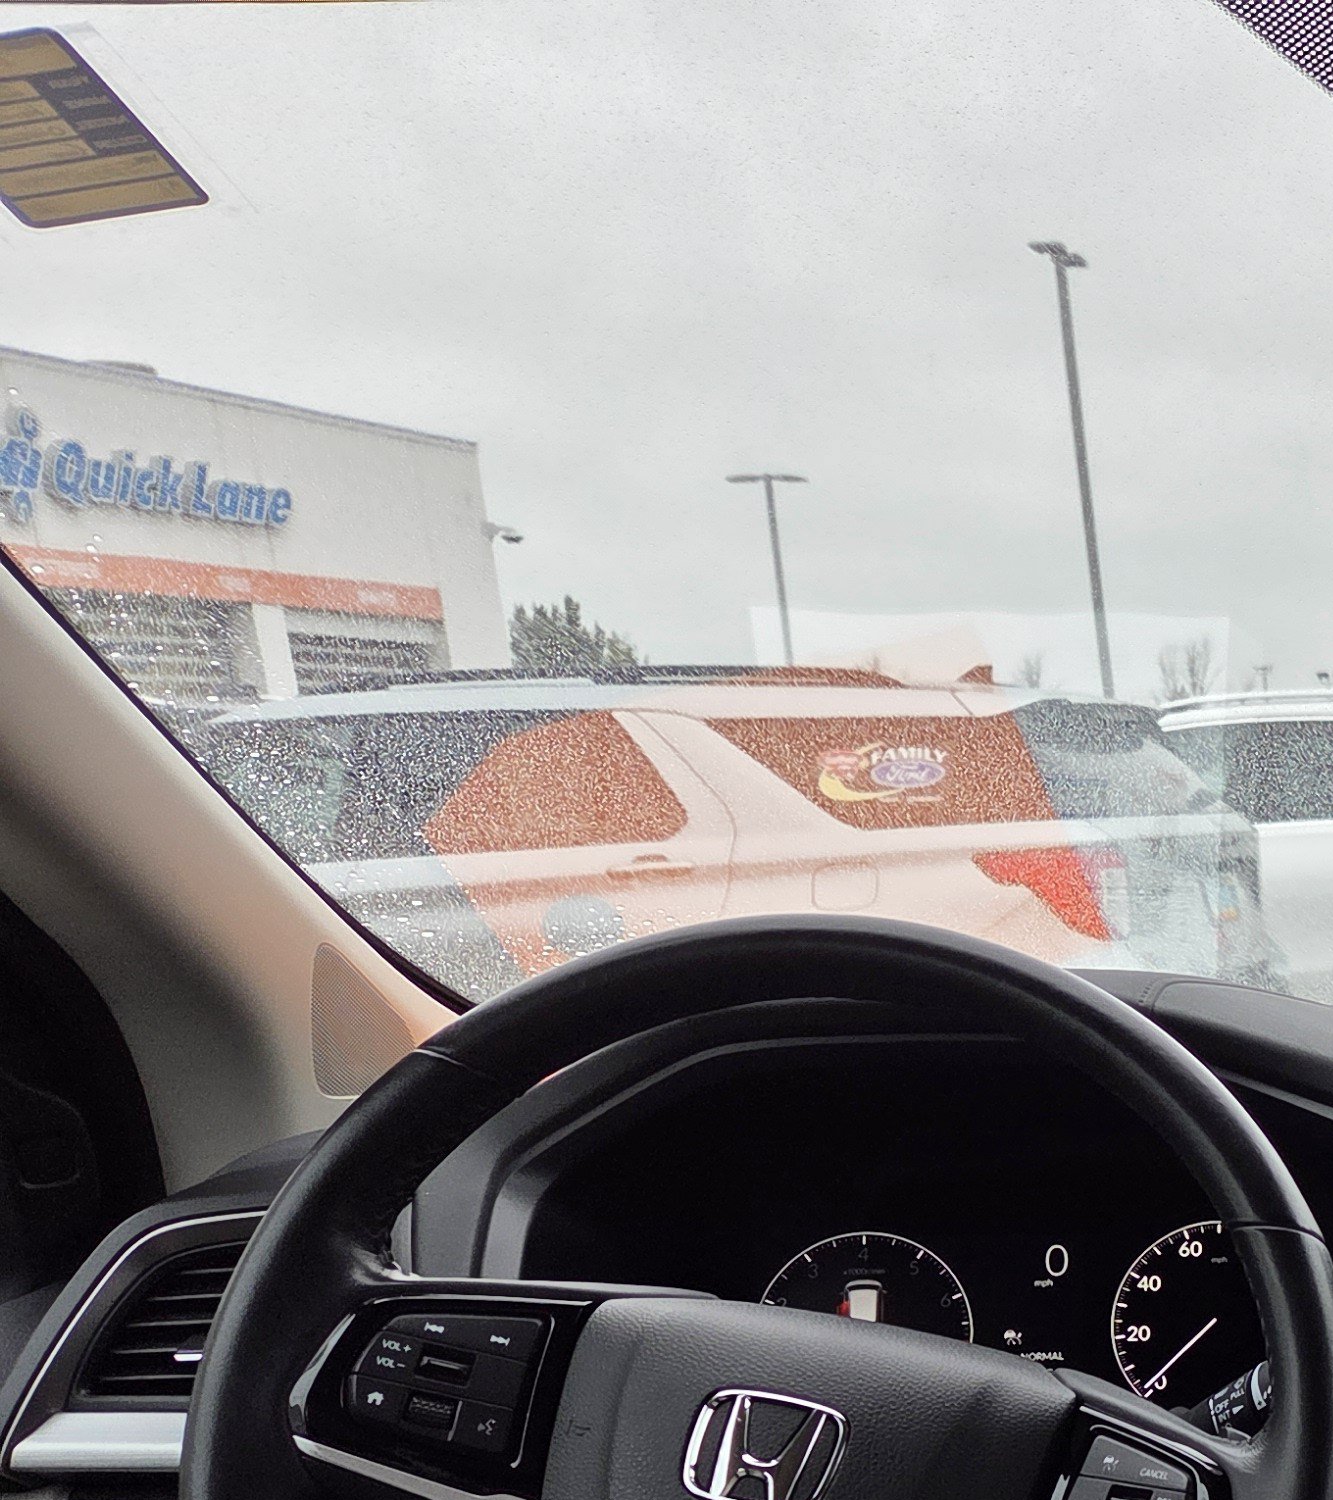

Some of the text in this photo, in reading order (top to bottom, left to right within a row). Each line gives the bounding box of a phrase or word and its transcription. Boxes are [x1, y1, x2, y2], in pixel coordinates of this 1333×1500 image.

[53, 440, 292, 526] Quick Lane
[870, 747, 949, 764] FAMILY
[1178, 1241, 1203, 1257] 60
[909, 1261, 920, 1276] 5
[1045, 1244, 1069, 1277] 0
[808, 1264, 819, 1279] 3
[1034, 1279, 1053, 1288] mph
[1137, 1275, 1162, 1292] 40
[1126, 1325, 1151, 1342] 20
[1215, 1399, 1229, 1414] OFF
[1140, 1467, 1168, 1480] CANCEL
